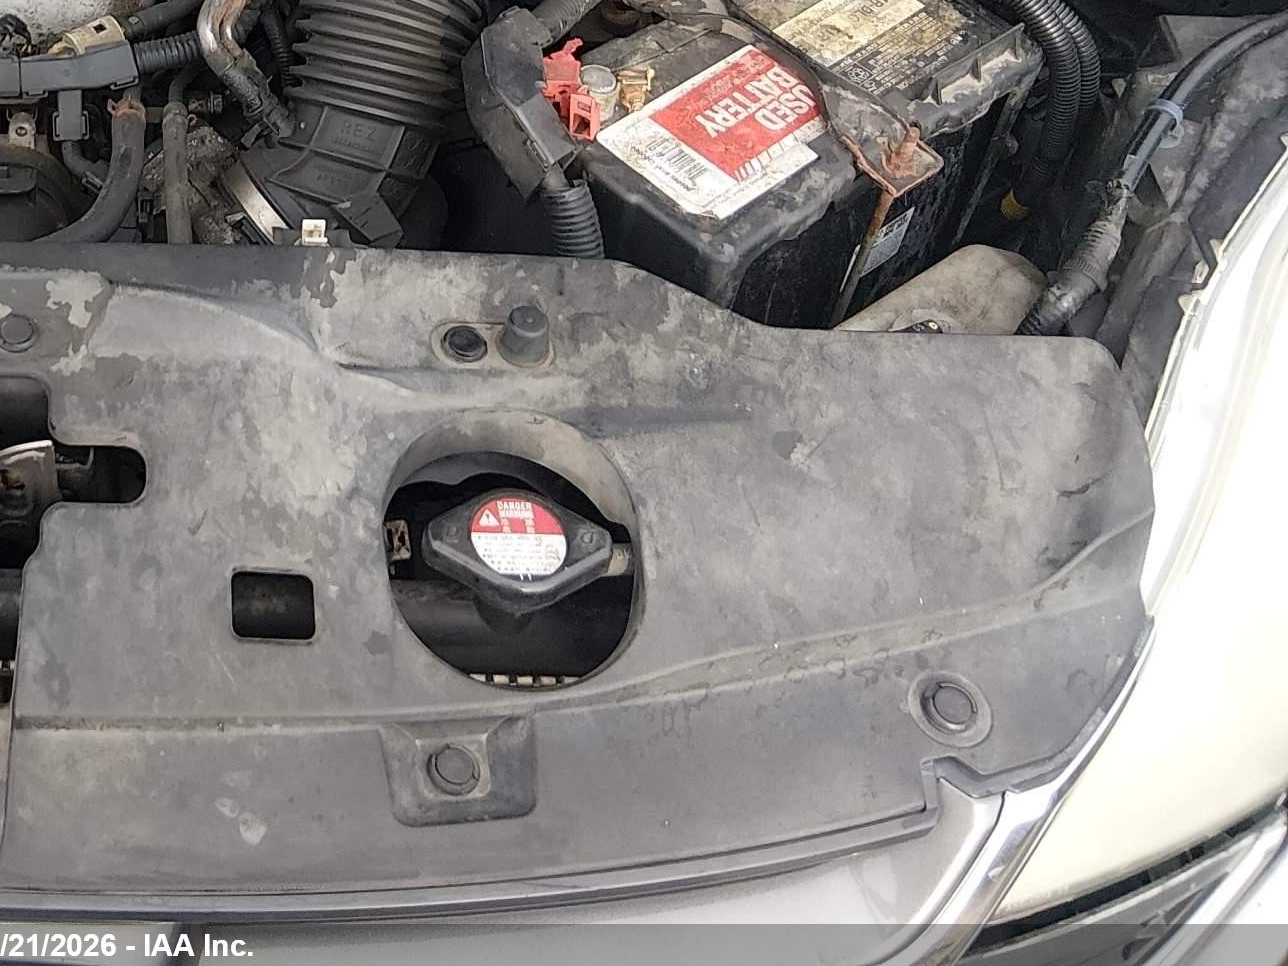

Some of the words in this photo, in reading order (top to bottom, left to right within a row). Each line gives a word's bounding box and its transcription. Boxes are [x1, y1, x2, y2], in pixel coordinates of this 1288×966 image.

[694, 66, 800, 139] BATTERY
[754, 84, 817, 131] USED
[496, 500, 532, 511] DANGER
